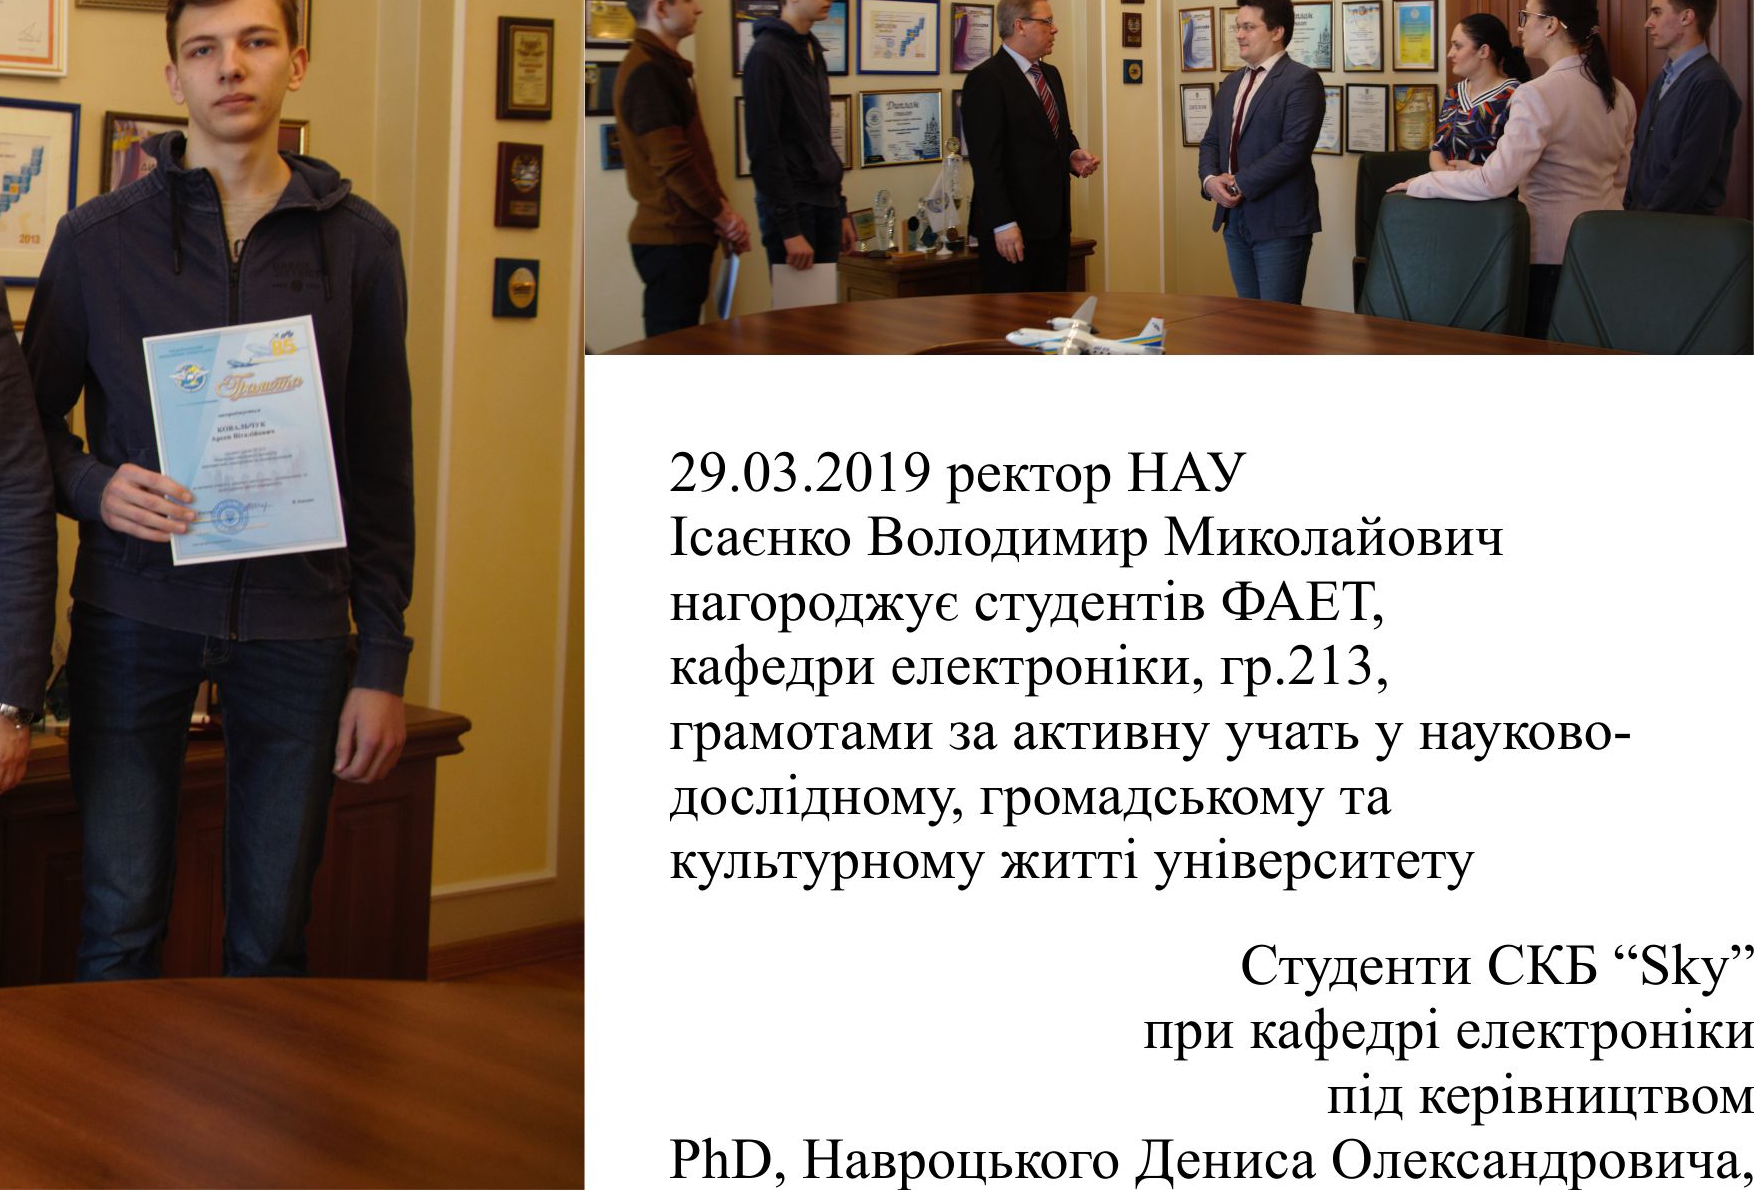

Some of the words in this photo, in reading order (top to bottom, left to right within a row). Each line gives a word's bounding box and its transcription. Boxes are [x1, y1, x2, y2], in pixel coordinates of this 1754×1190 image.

[18, 234, 41, 244] 2013
[271, 338, 296, 357] 85
[215, 372, 304, 402] Грамота
